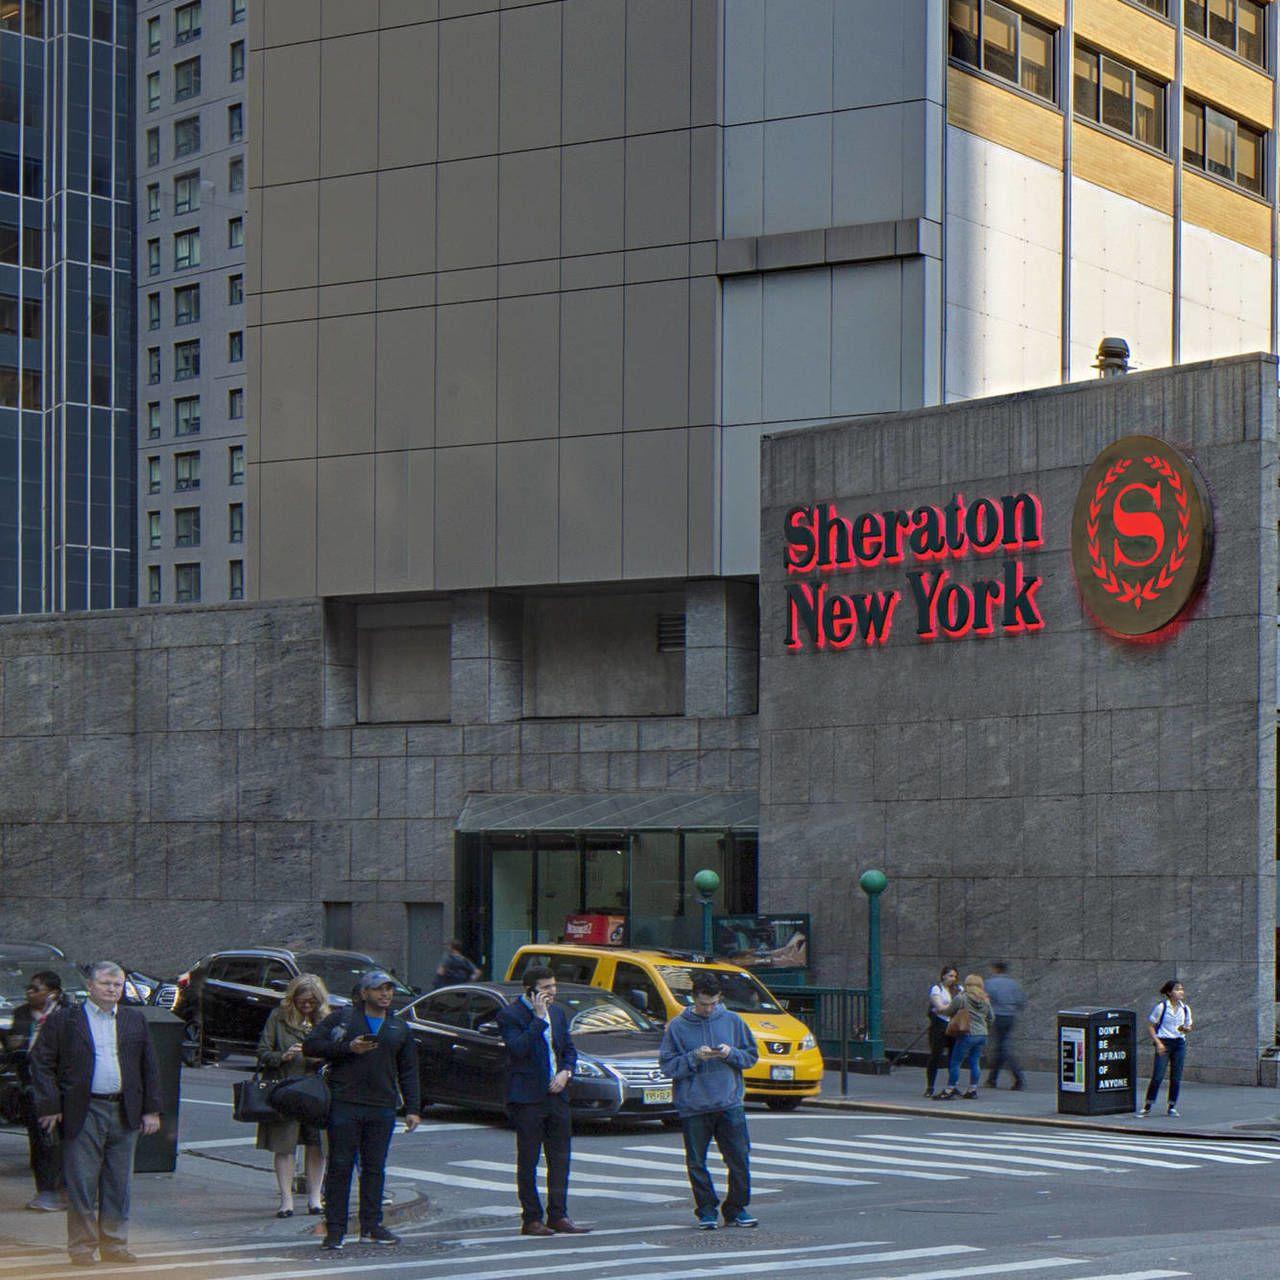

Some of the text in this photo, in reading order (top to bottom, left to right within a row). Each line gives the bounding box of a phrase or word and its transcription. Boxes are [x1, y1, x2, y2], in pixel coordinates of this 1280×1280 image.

[1112, 481, 1166, 567] S
[784, 491, 1042, 573] Sheraton
[784, 560, 1043, 649] New York
[1098, 1039, 1109, 1049] BE
[1098, 1051, 1127, 1061] AFRAID
[1098, 1065, 1109, 1075] OF
[1099, 1078, 1129, 1089] ANYONE
